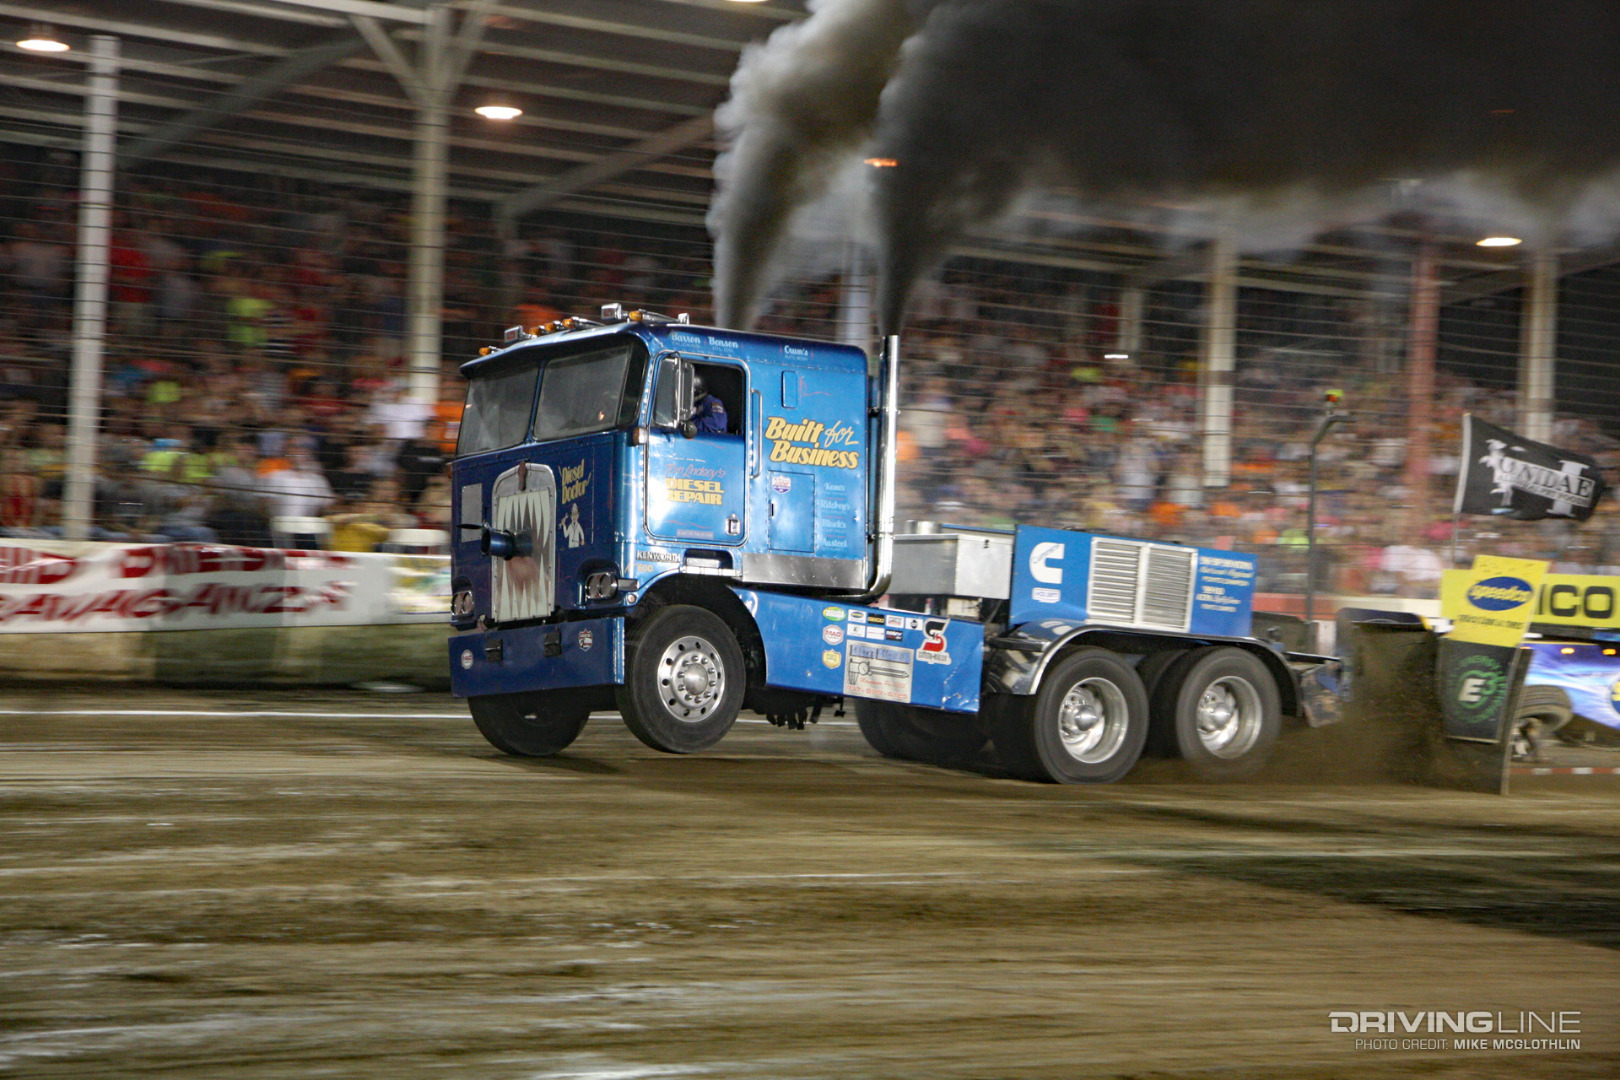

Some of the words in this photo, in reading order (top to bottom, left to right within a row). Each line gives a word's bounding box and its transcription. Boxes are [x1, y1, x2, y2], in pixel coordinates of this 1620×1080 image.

[708, 336, 739, 348] Benson
[764, 416, 825, 444] Built
[824, 420, 860, 448] for
[769, 440, 860, 470] Business
[562, 458, 585, 486] Diesel
[562, 480, 588, 504] Doctor
[665, 478, 725, 494] DIESEL
[665, 490, 723, 506] REPAIR
[636, 550, 680, 563] KENWORTH
[1468, 584, 1532, 603] speedco
